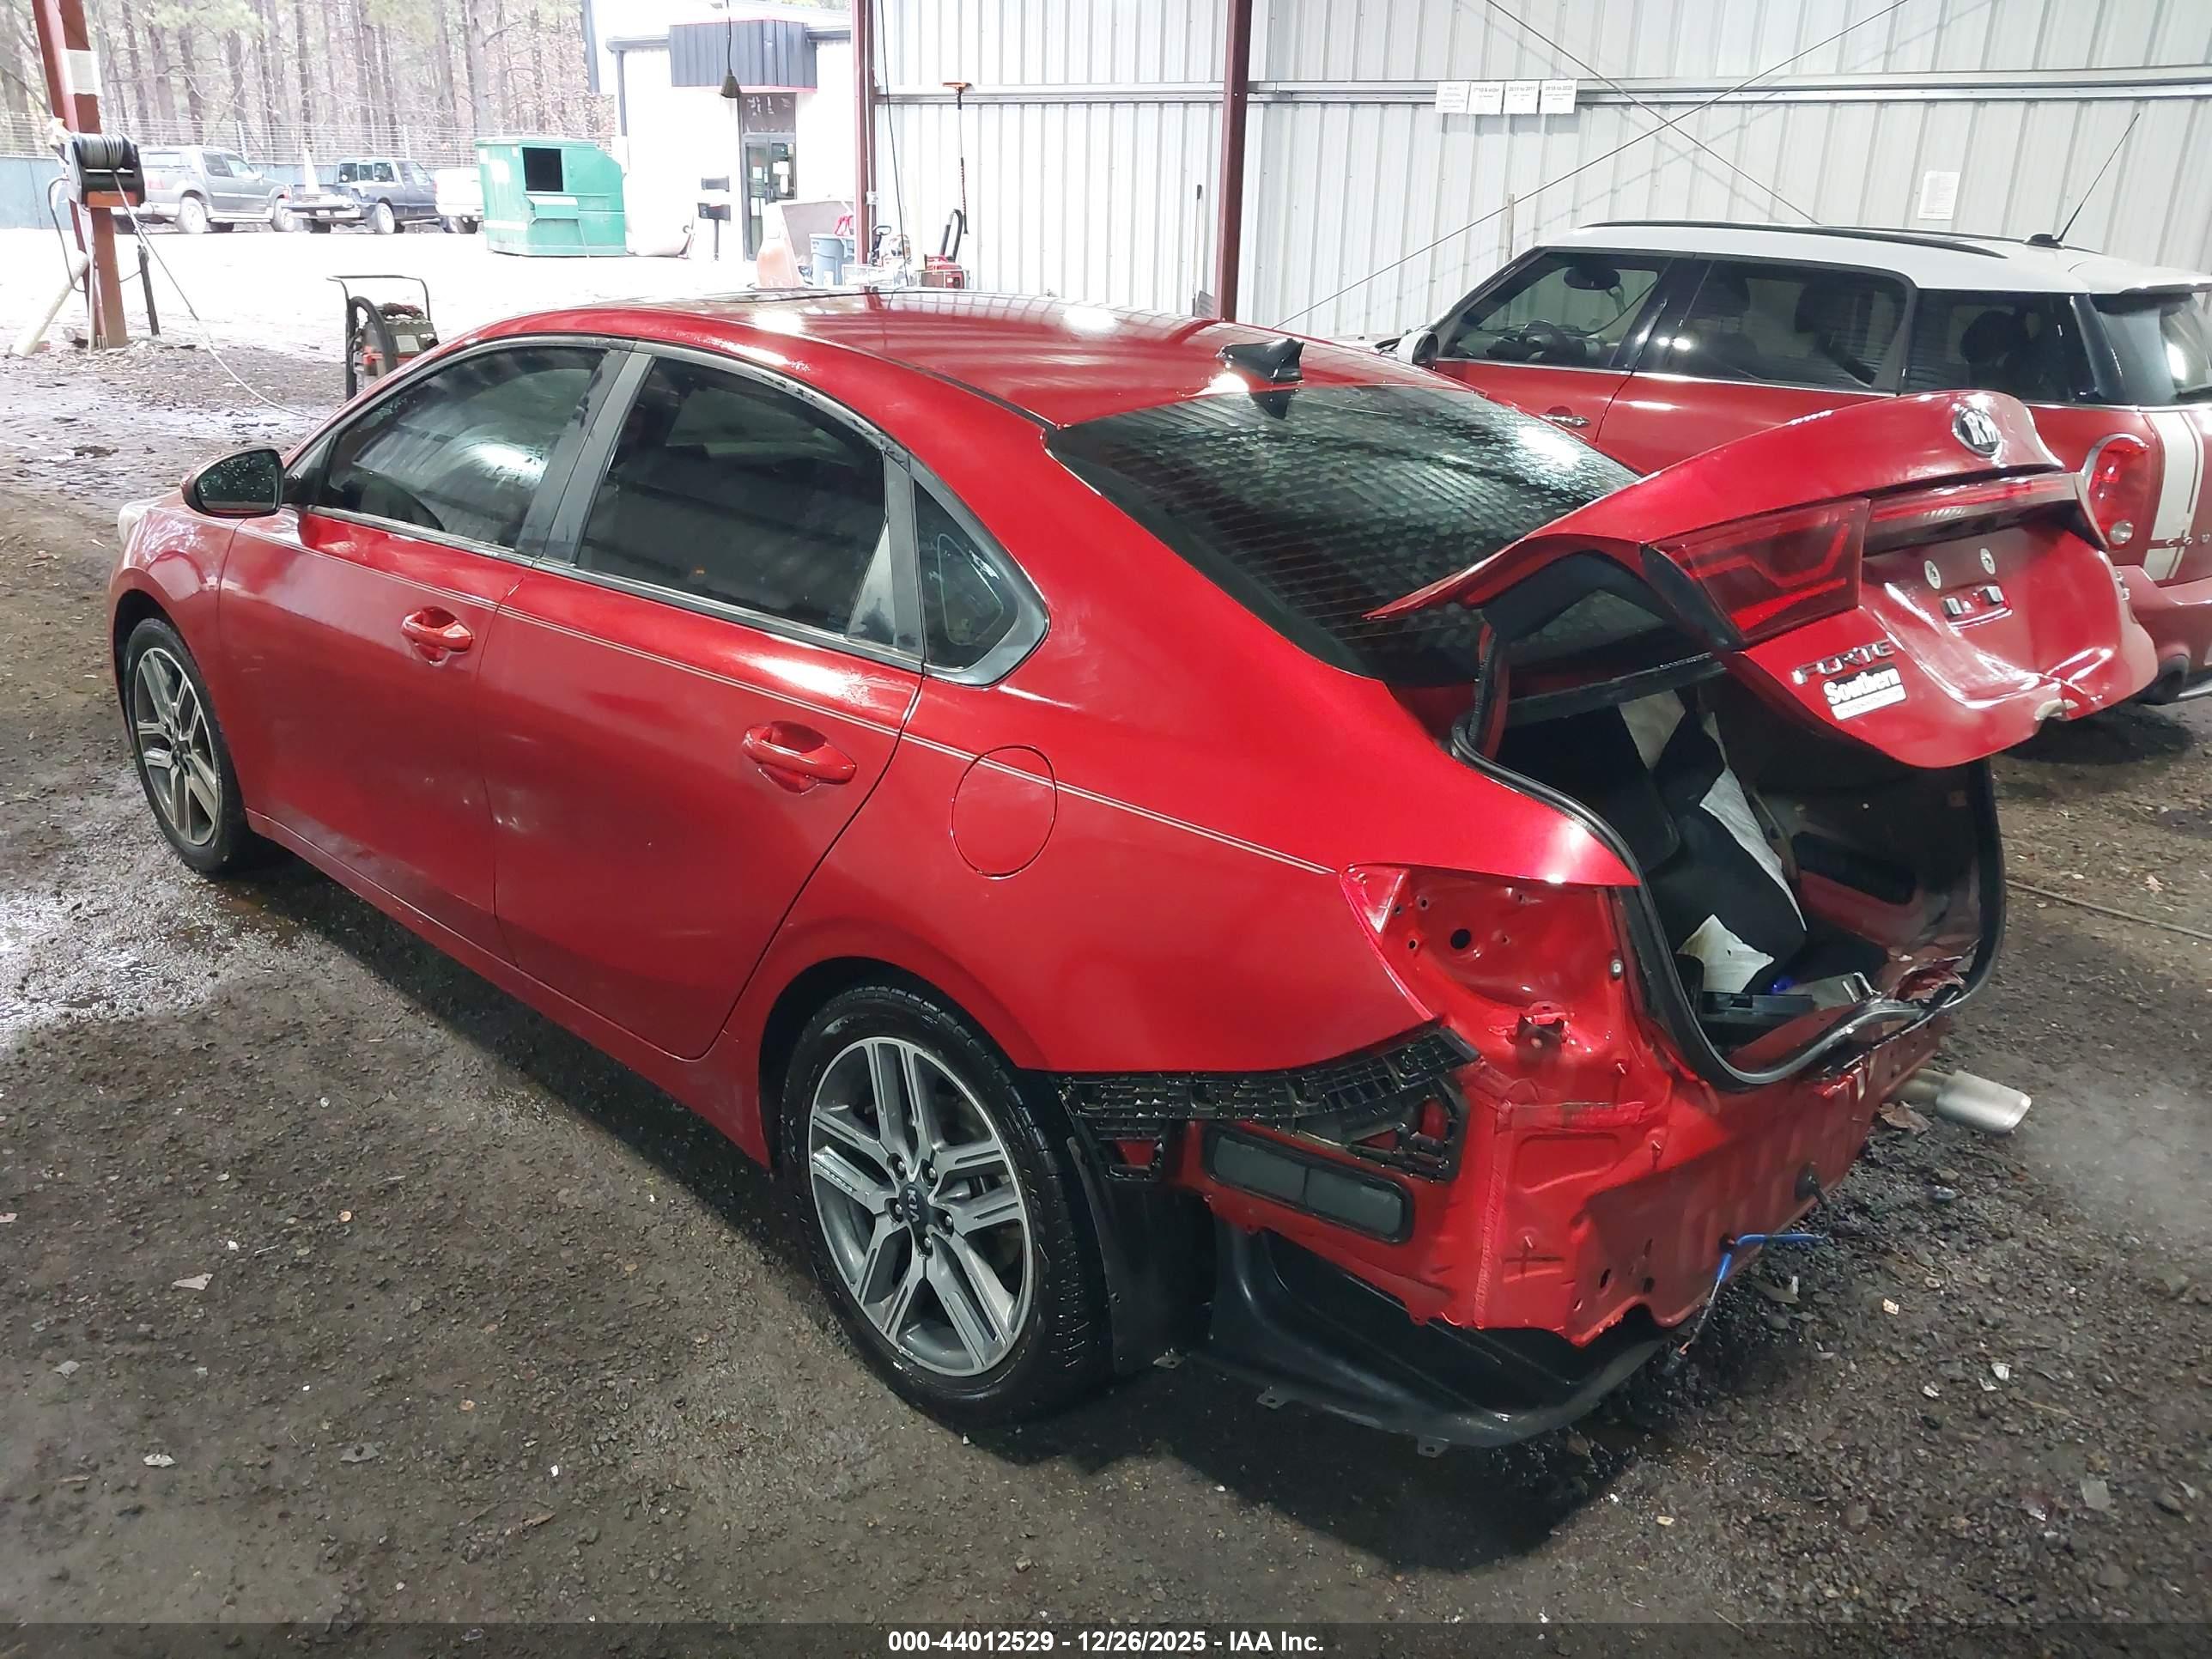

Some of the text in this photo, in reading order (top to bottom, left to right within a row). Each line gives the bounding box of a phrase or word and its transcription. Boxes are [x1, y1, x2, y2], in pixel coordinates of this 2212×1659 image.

[1791, 639, 1895, 685] FORTE
[1823, 667, 1901, 705] Southern
[907, 1188, 920, 1223] KIA
